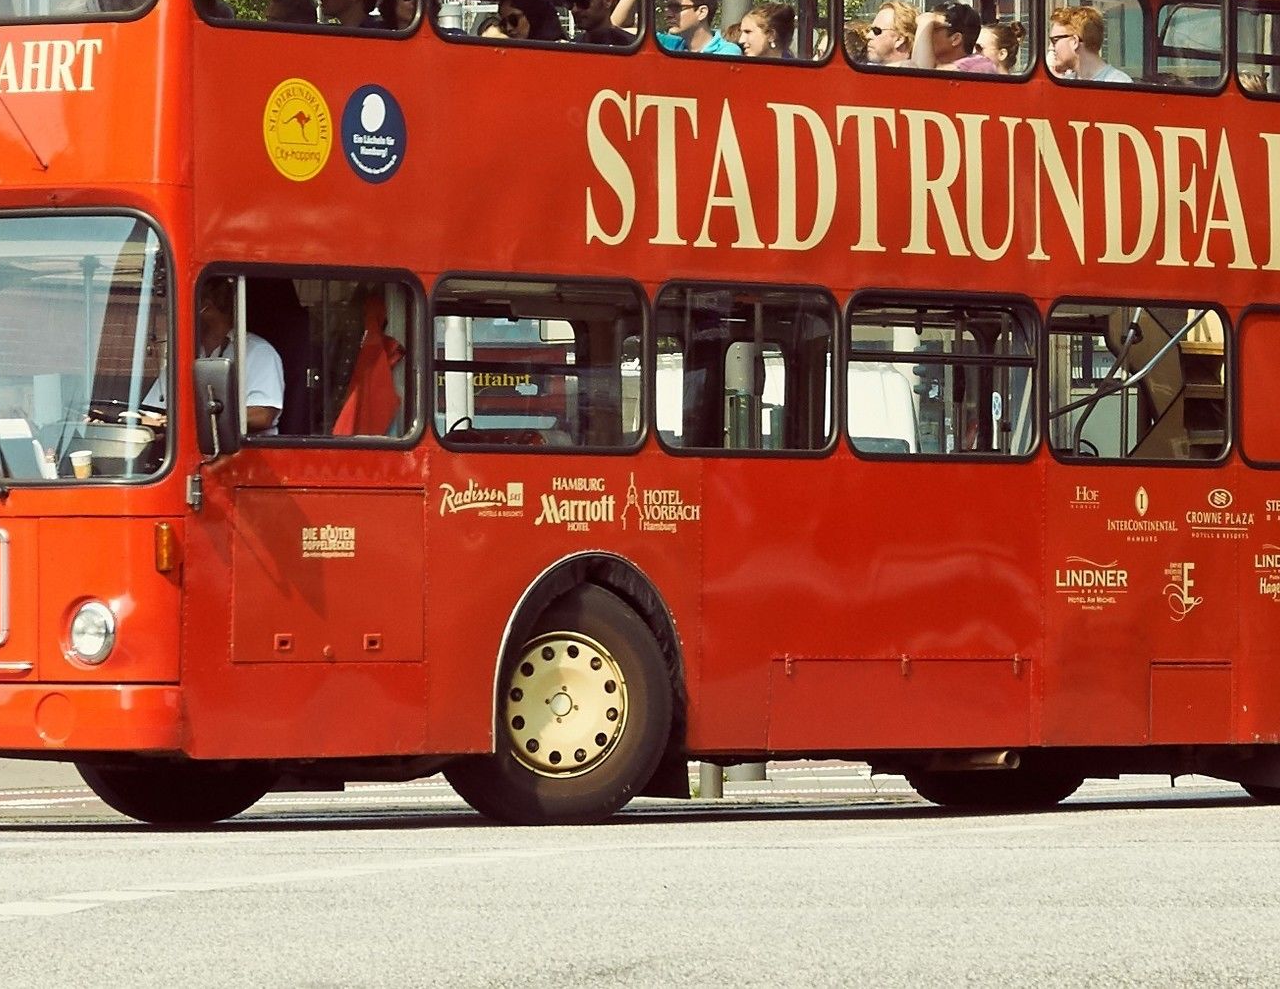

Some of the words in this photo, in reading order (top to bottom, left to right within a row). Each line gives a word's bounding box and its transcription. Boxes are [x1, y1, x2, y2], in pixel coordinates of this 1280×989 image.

[437, 372, 531, 387] rdfahrt
[552, 477, 605, 492] HAMBURG
[439, 478, 507, 517] Radisson
[643, 490, 683, 505] HOTEL
[534, 493, 616, 525] Marriott
[644, 505, 701, 521] VORBACH
[1185, 511, 1222, 524] CROWNE
[1225, 512, 1254, 525] PLAZA
[567, 522, 590, 532] HOTEL
[643, 522, 677, 534] Hamburg
[1055, 569, 1128, 587] LINDNER
